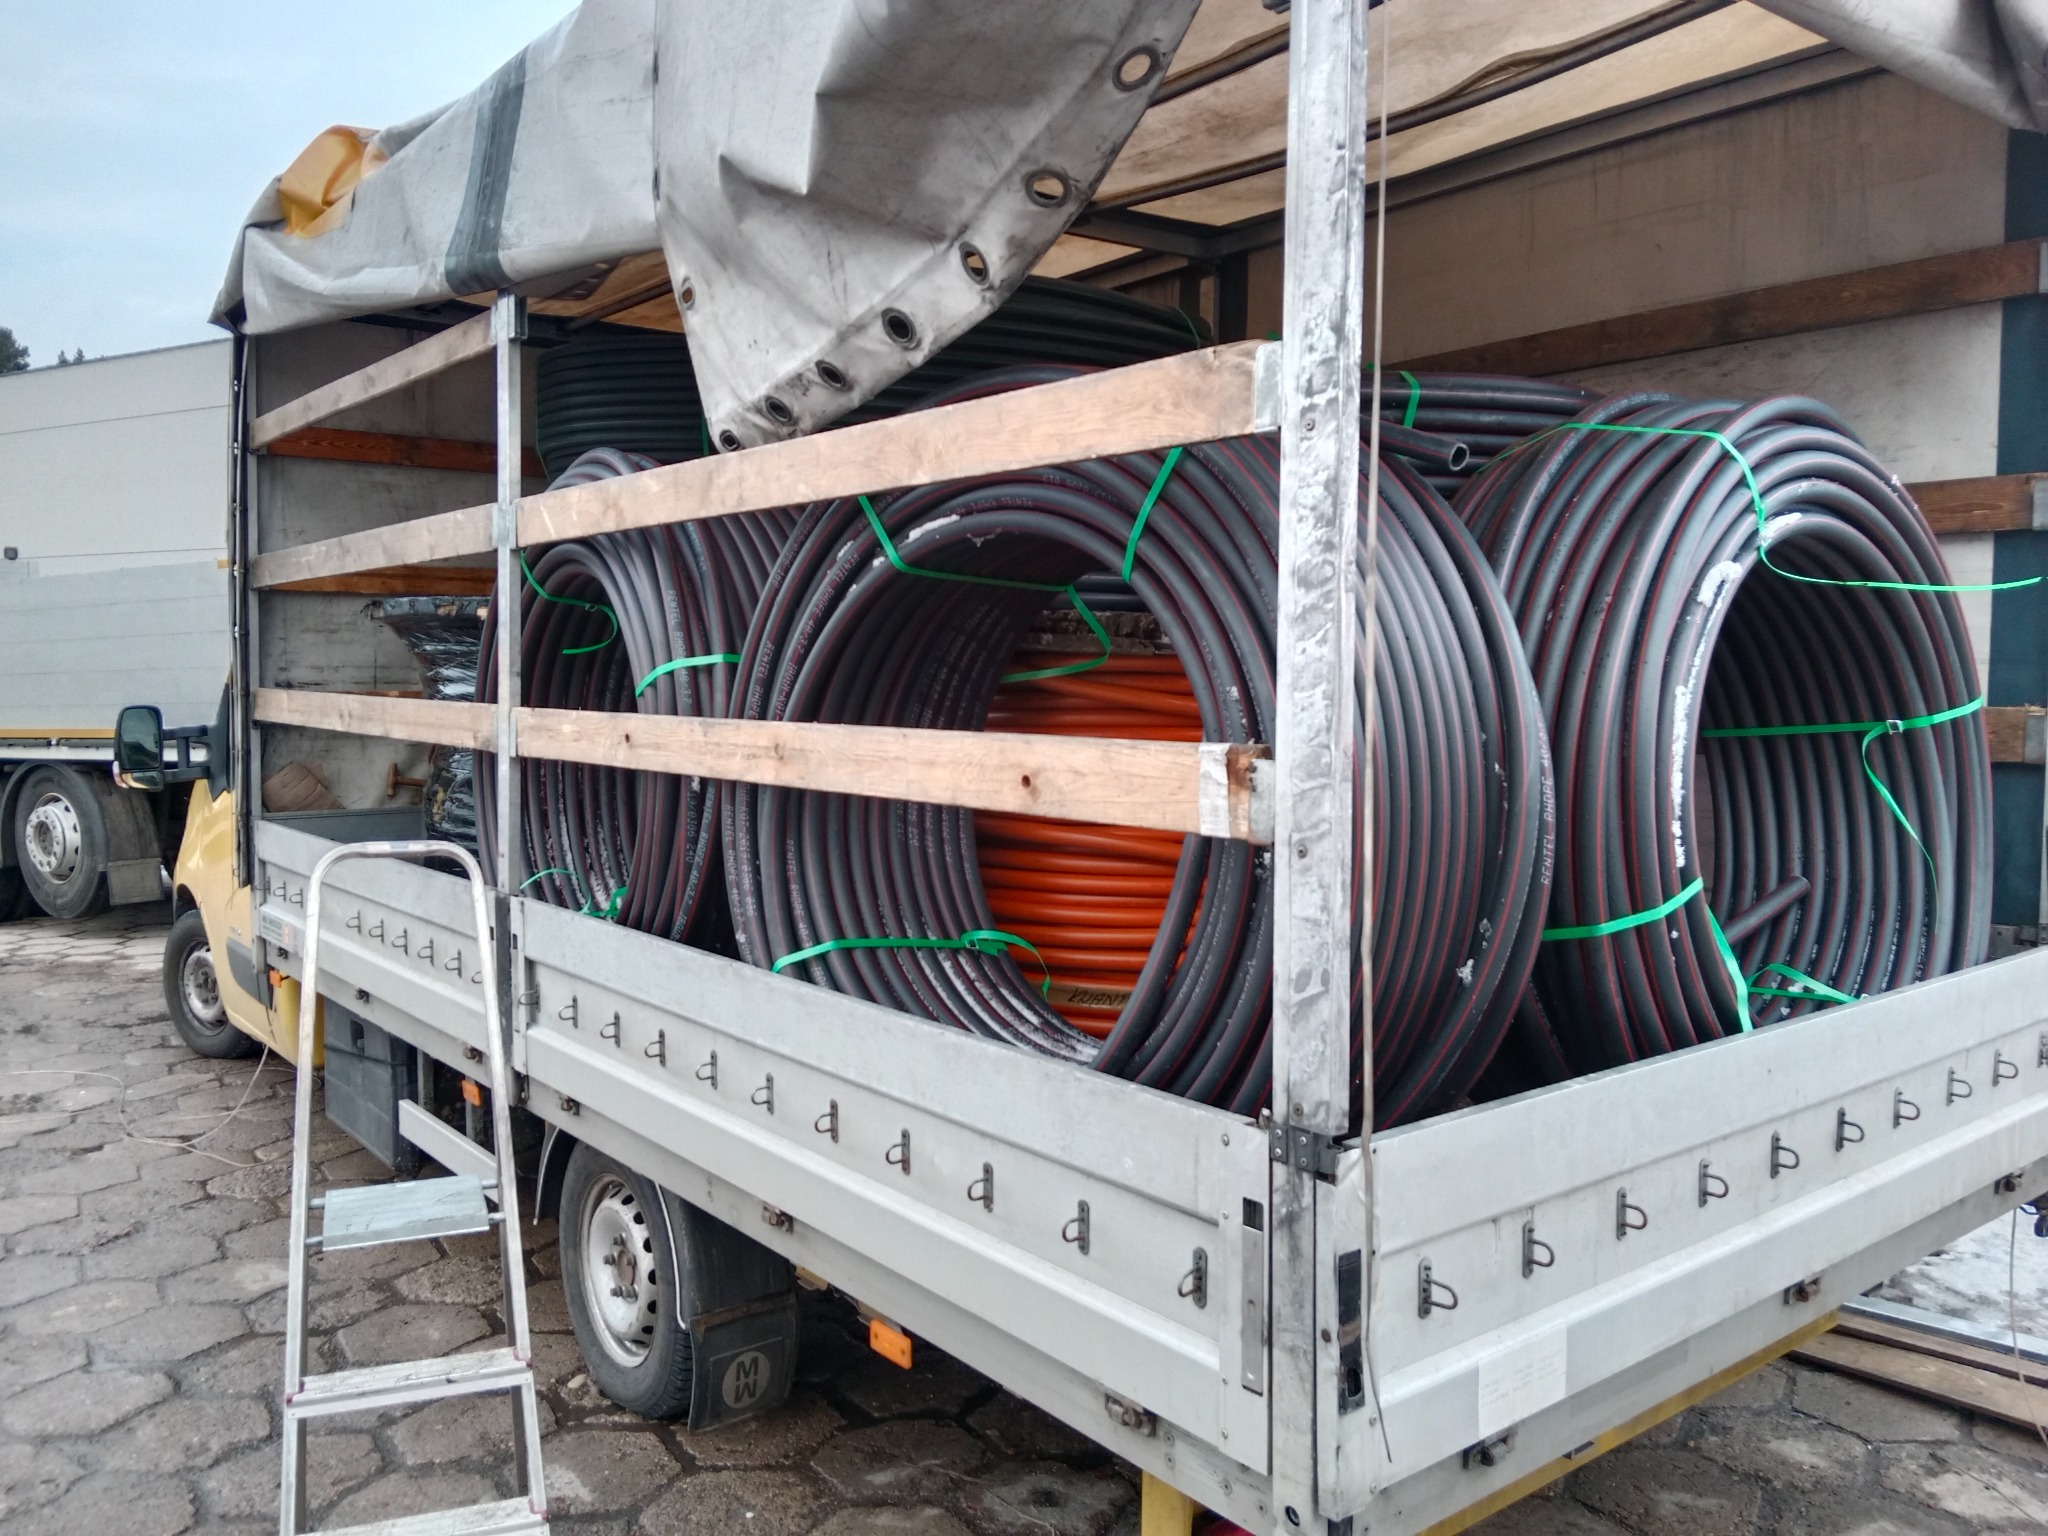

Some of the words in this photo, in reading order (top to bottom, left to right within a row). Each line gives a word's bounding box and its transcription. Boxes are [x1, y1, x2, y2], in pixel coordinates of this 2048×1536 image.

[755, 639, 775, 680] RENTEL
[723, 803, 736, 843] RENTEL
[727, 849, 739, 882] RHDPE
[1540, 834, 1555, 886] RENTEL
